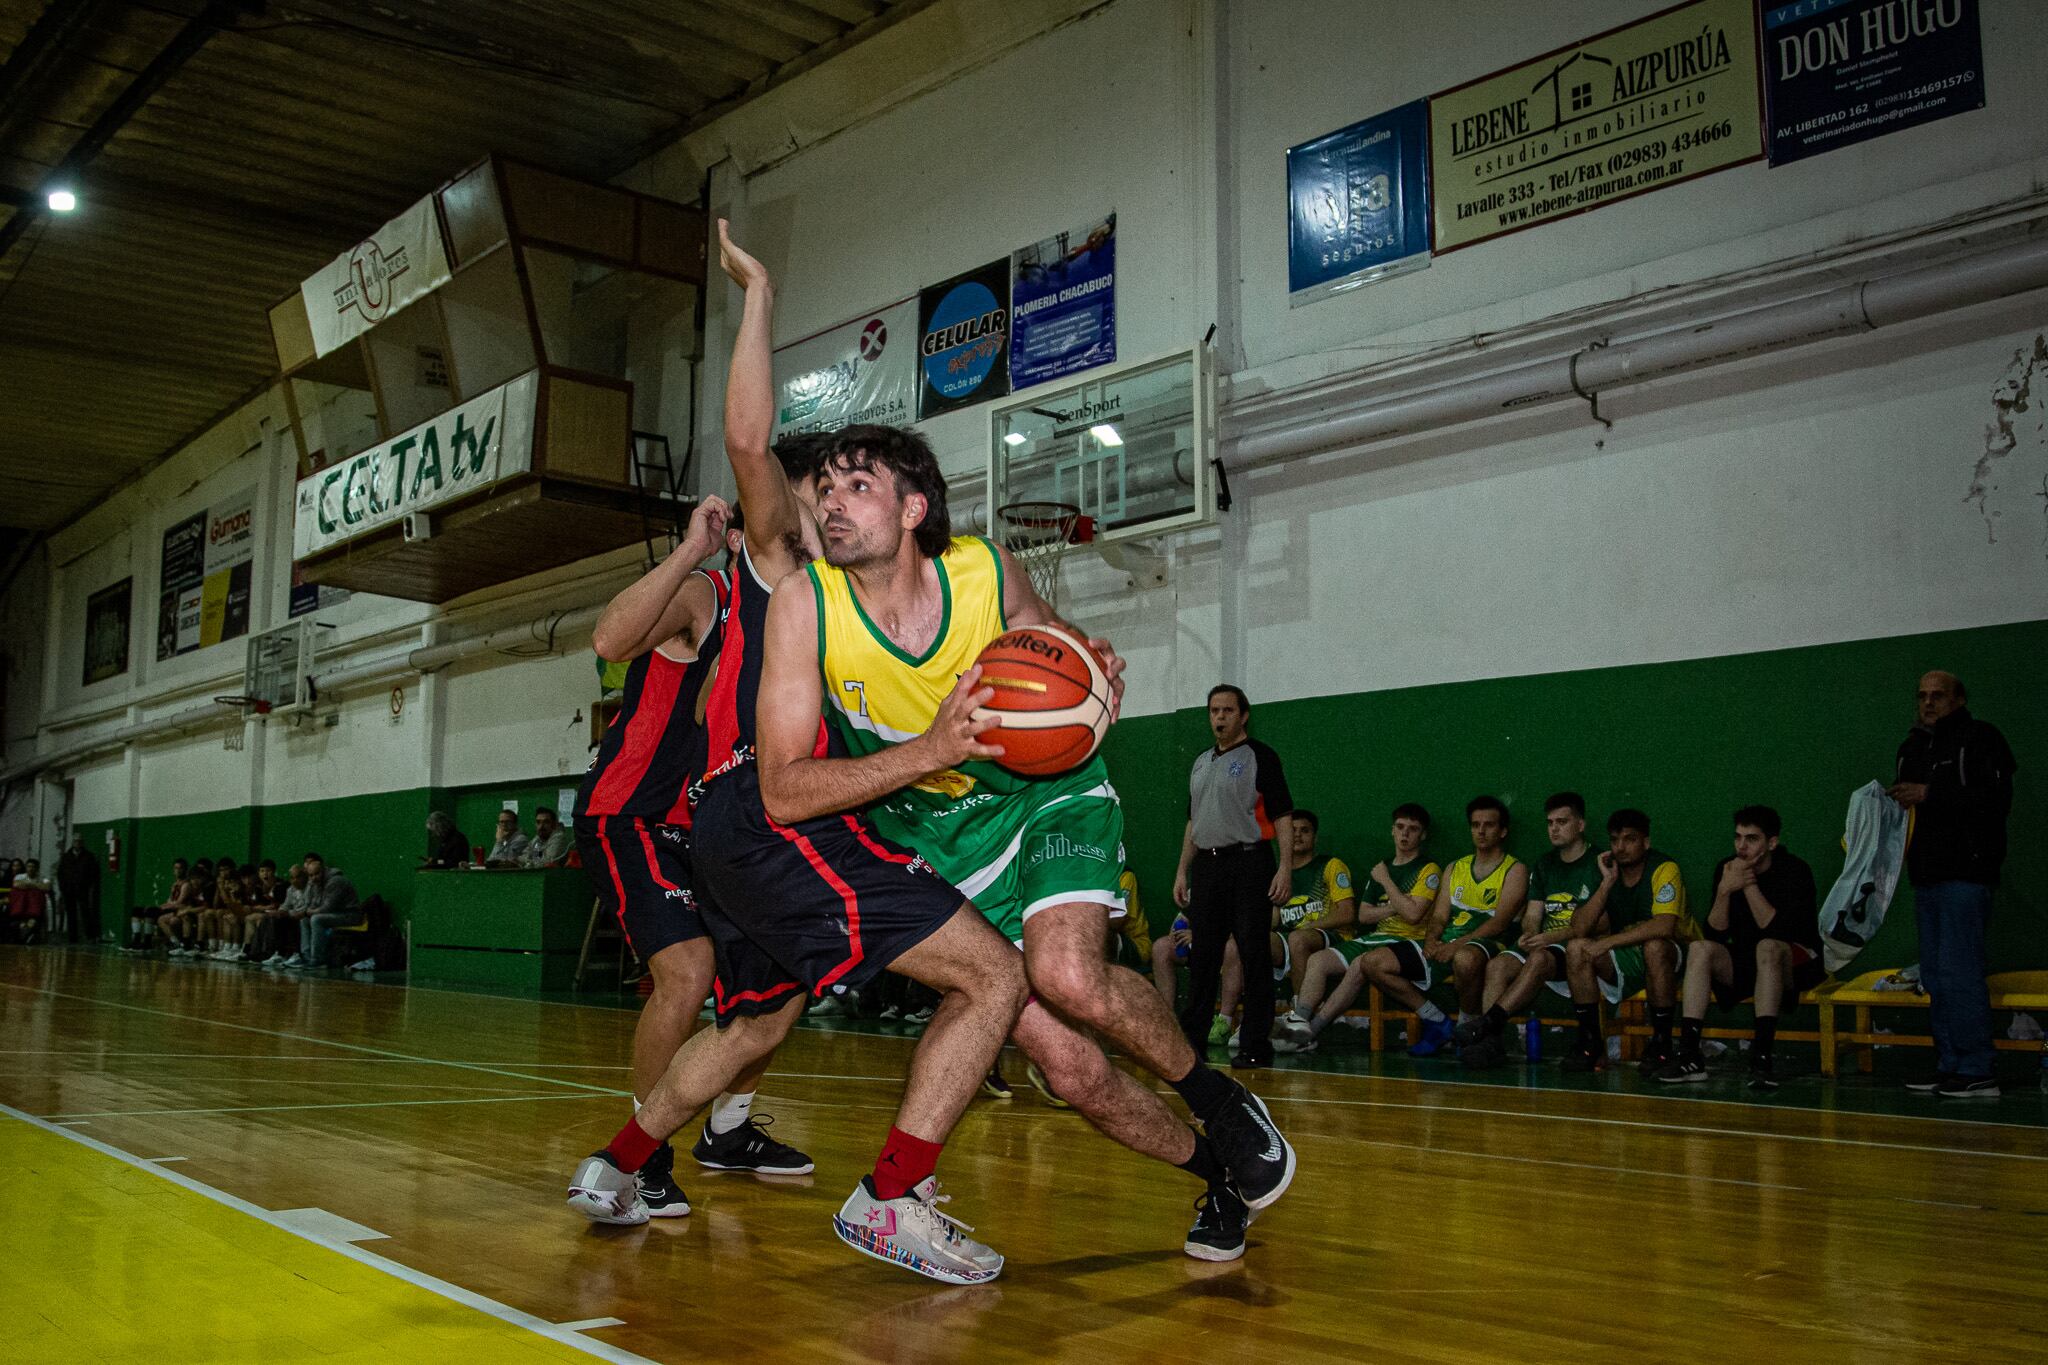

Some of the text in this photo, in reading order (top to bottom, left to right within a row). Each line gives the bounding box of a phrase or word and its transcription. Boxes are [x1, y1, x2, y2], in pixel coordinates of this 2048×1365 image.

[1778, 0, 1962, 81] DON HUGO
[1451, 25, 1732, 156] LEBENE AIZPURÚA
[1475, 91, 1706, 177] estudio inmobiliario
[1777, 128, 1793, 139] AV.
[1796, 109, 1846, 134] LIBERTAD
[1849, 103, 1869, 117] 162
[1803, 95, 1946, 144] veterinariadonhugo@gmail.com
[1457, 194, 1506, 221] Lavalle
[1509, 181, 1535, 203] 333
[1548, 162, 1603, 193] Tel/Fax
[1607, 141, 1667, 176] (02983)
[1671, 118, 1732, 153] 434666
[1499, 159, 1684, 226] www.lebene-aizpurua.com.ar
[1321, 234, 1395, 269] seguros
[1014, 273, 1113, 318] PLOMERIA CHACABUCO
[922, 308, 1006, 357] CELULAR
[847, 402, 887, 427] ARROYOS
[888, 398, 907, 413] S.A.
[843, 680, 868, 717] 7
